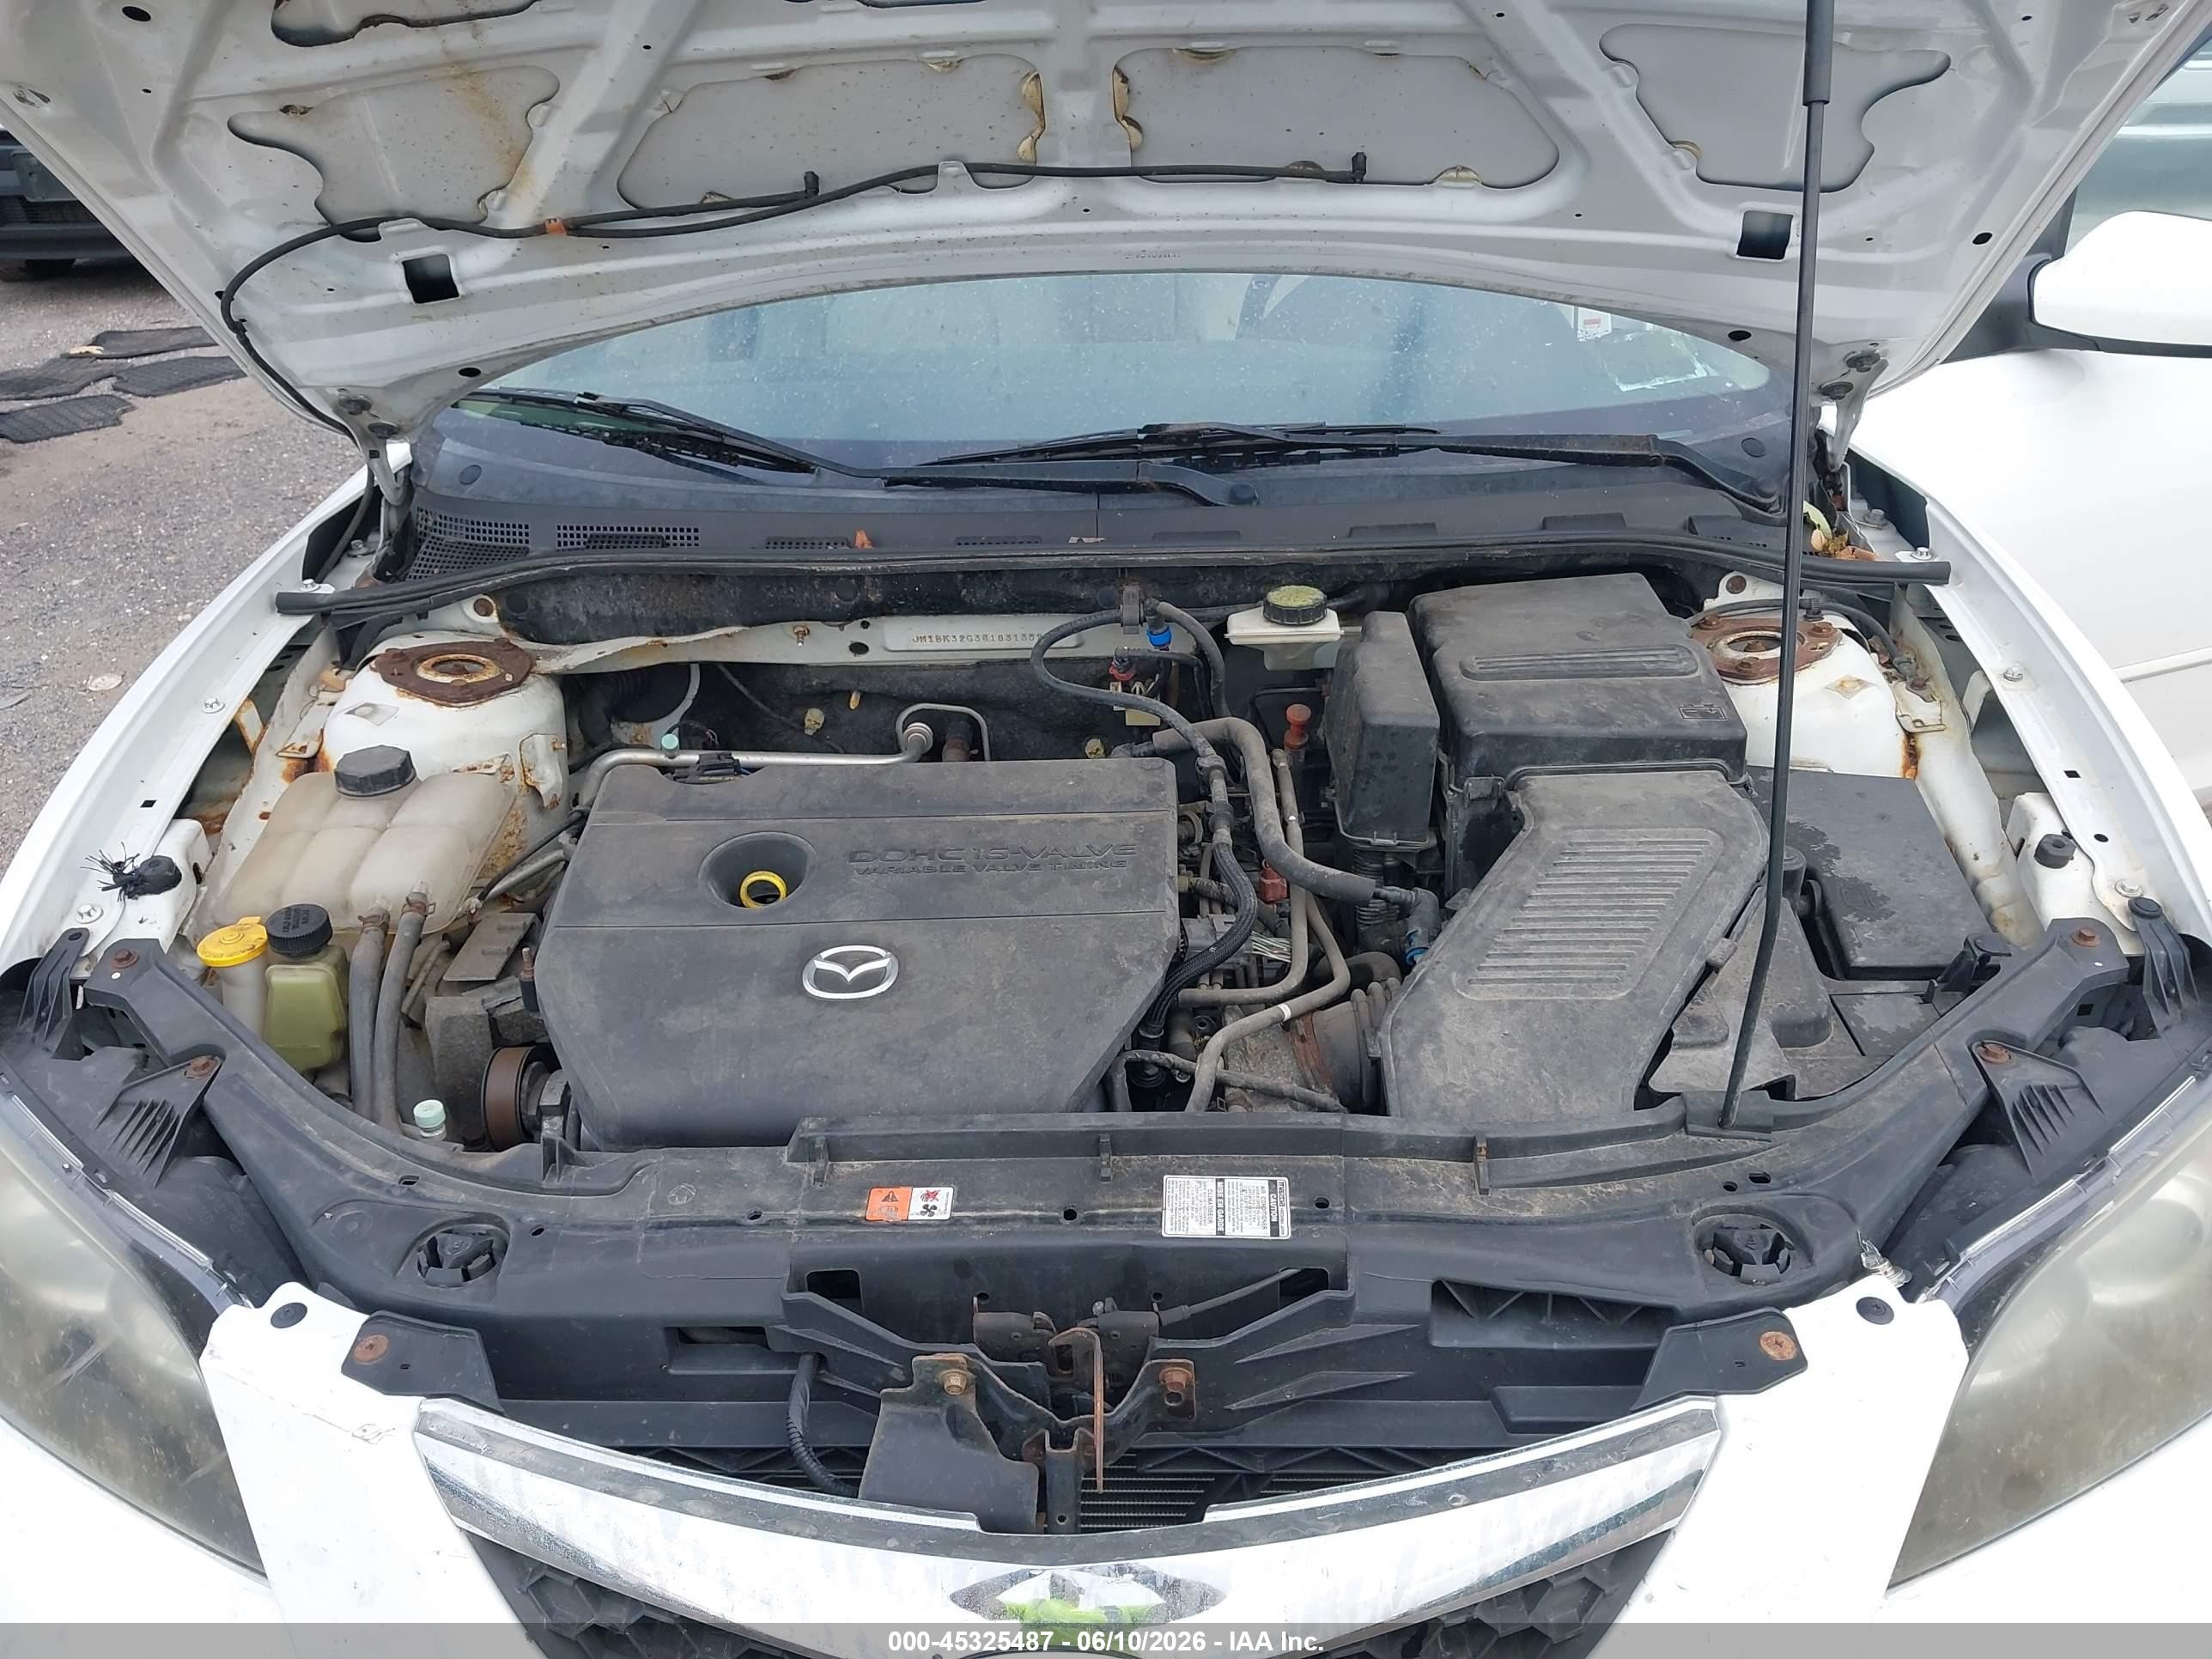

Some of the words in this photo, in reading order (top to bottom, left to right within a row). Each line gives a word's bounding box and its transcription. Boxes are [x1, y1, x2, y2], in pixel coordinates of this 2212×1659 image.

[848, 848, 965, 864] DOHC
[972, 843, 1139, 860] 16-VALVE
[854, 864, 967, 876] VARIABLE
[972, 862, 1042, 874] VALVE
[1049, 860, 1128, 871] TIMING
[1217, 1199, 1224, 1208] EN
